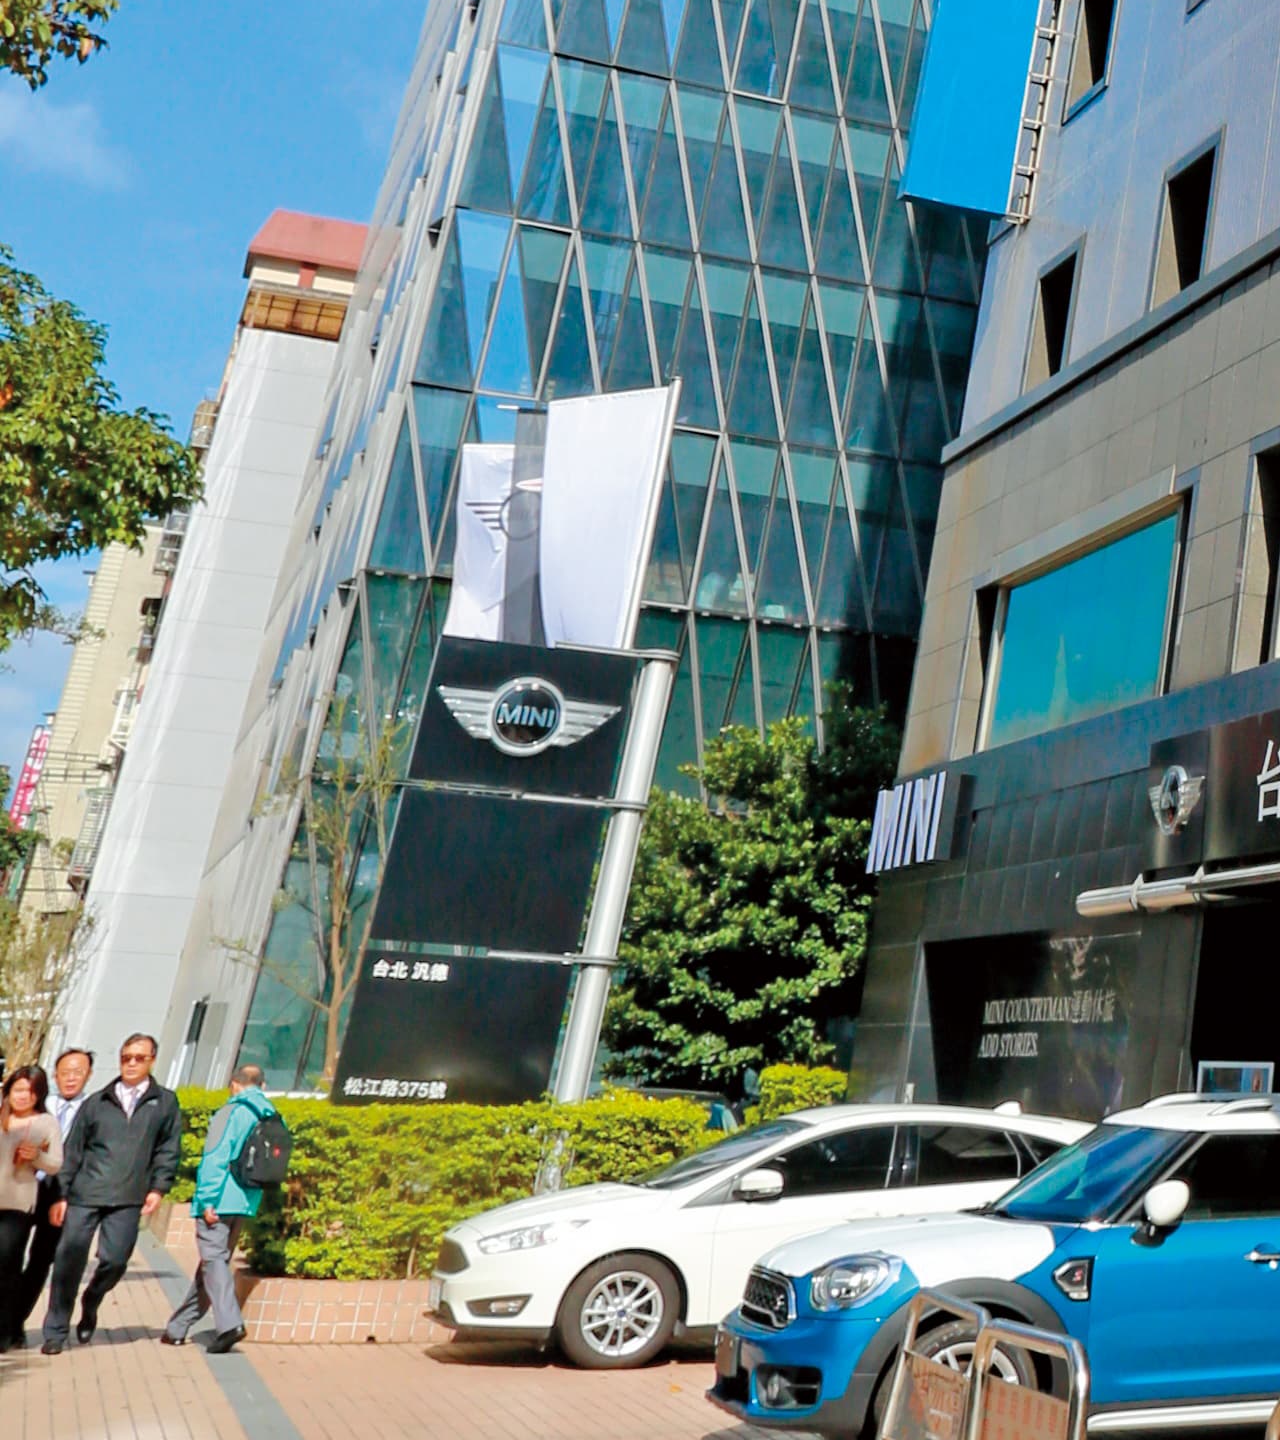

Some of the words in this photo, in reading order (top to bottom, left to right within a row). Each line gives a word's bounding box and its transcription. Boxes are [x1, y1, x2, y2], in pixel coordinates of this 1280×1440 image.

[498, 703, 556, 729] MINI
[865, 770, 948, 875] MINI
[373, 959, 408, 979] 台北
[983, 999, 1005, 1024] MINI
